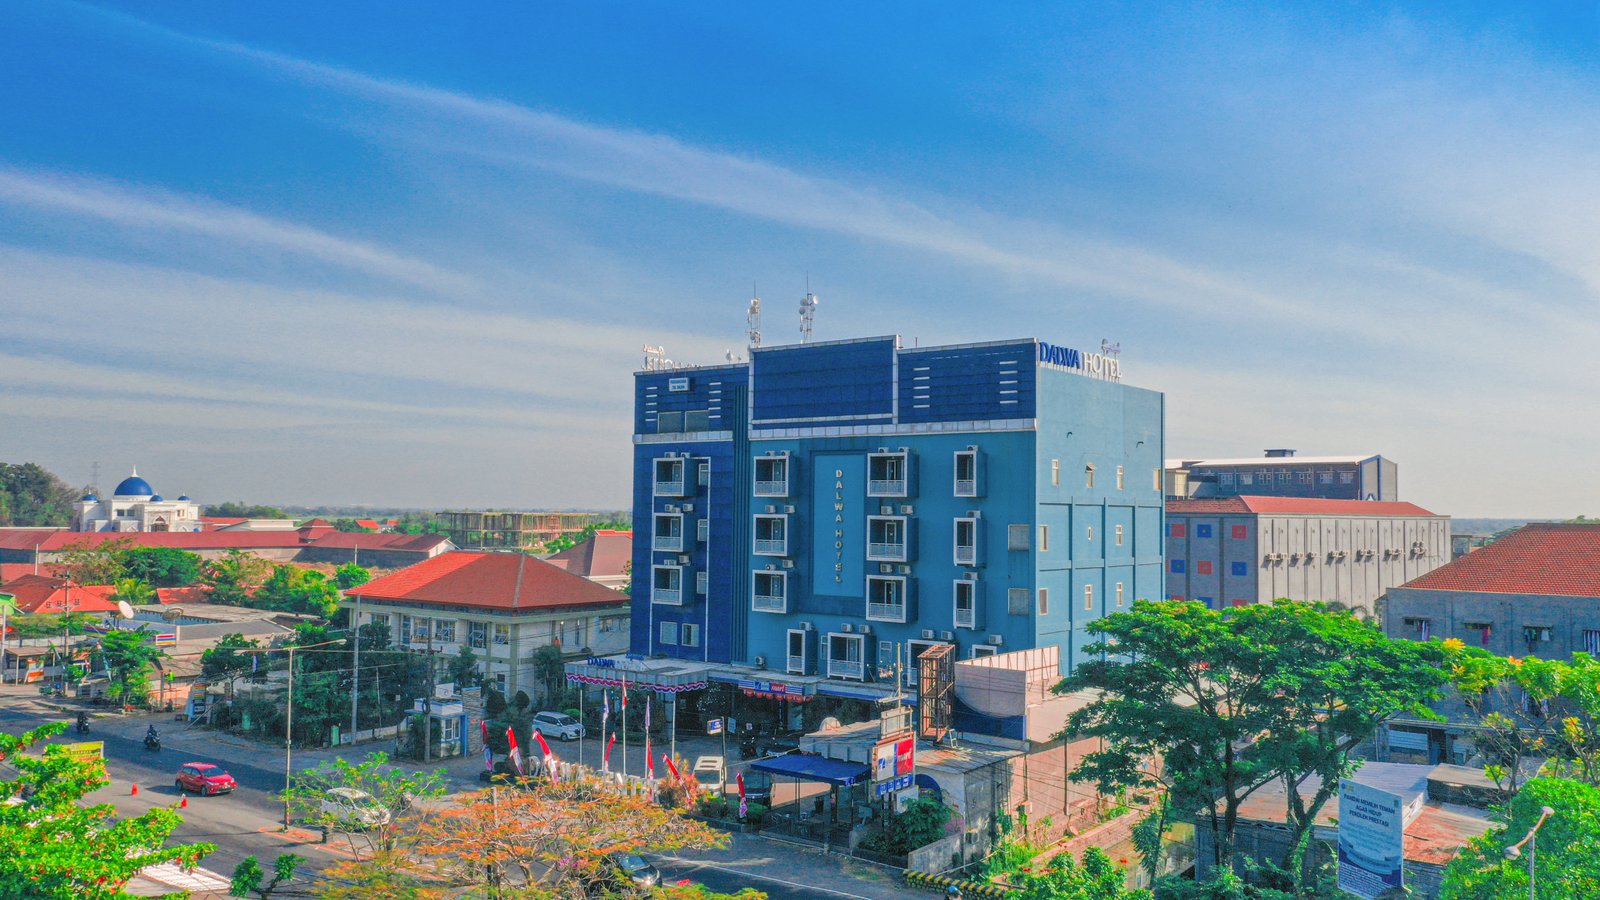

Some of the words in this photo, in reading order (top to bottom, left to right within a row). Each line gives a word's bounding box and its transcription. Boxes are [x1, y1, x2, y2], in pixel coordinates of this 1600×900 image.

[1039, 342, 1080, 369] DALWA
[1082, 352, 1122, 377] HOTEL
[835, 469, 843, 522] DALWA
[587, 656, 615, 668] DALWA
